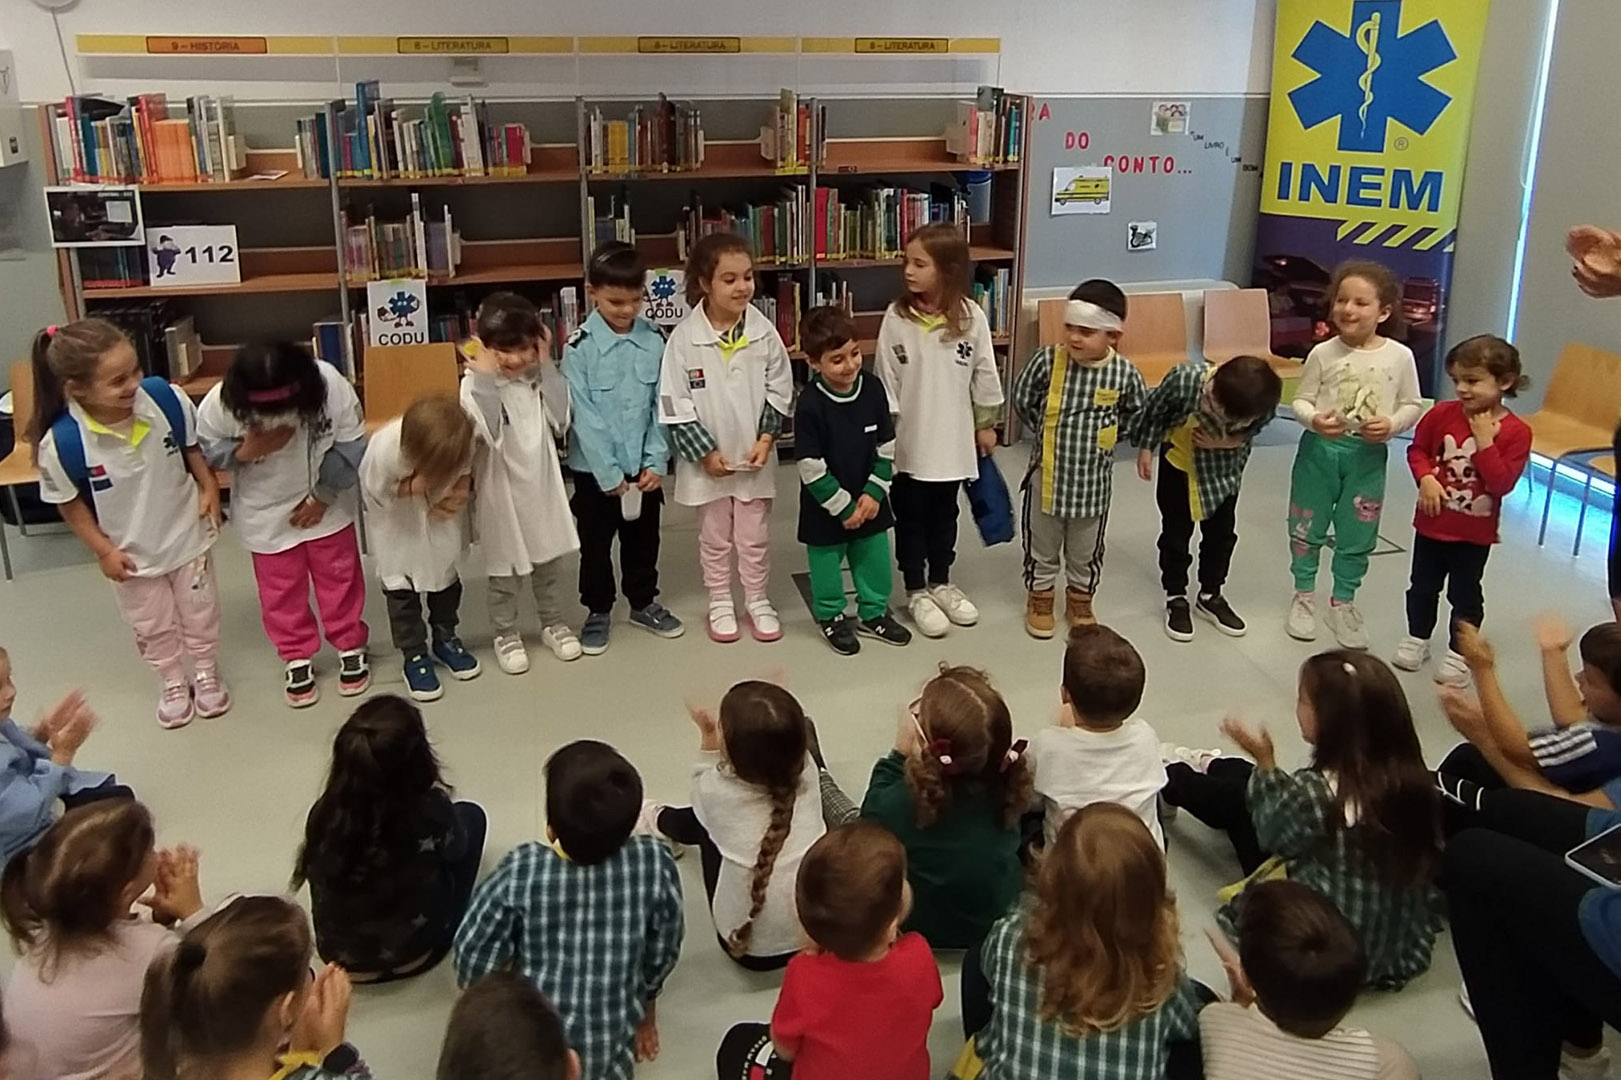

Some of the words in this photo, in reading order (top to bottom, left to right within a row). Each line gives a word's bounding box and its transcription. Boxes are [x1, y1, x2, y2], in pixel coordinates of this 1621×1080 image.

[171, 41, 178, 51] 9
[431, 41, 491, 50] LITERATURA
[670, 41, 726, 50] LITERATURA
[884, 41, 935, 50] LITERATURA
[1065, 131, 1090, 150] DO
[1277, 161, 1445, 213] INEM
[185, 245, 235, 264] 112
[645, 307, 684, 319] CODU
[378, 331, 425, 346] CODU
